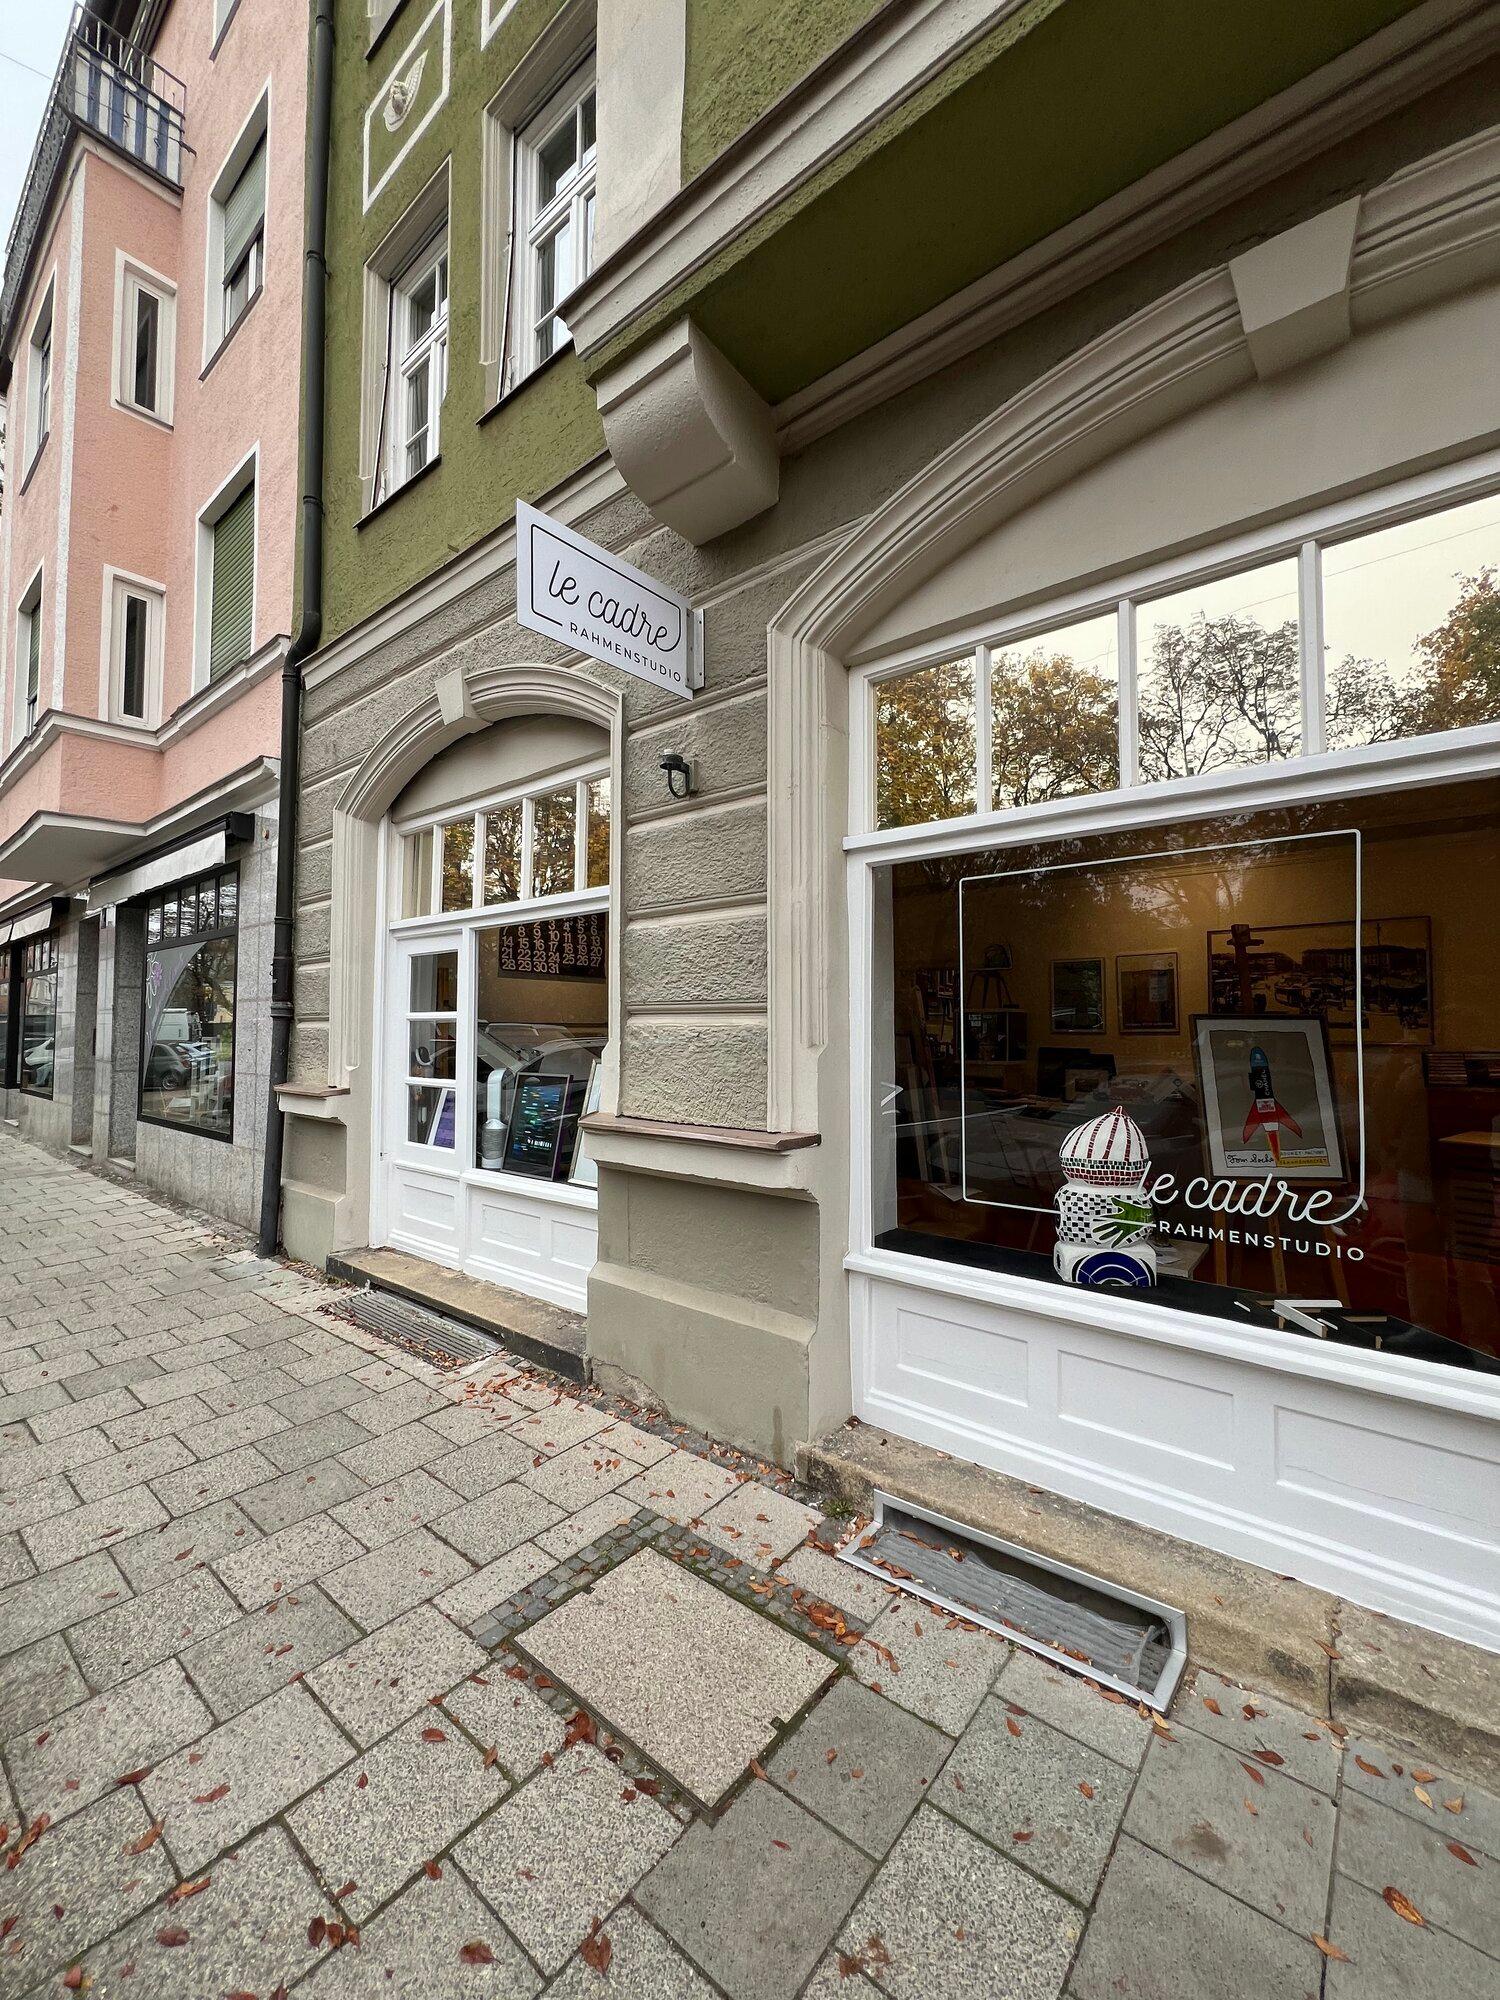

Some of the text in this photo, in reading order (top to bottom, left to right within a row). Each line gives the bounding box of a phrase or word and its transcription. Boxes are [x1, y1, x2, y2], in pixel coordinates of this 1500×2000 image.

[549, 560, 678, 652] le cadre
[570, 622, 681, 682] RAHMENSTUDIO
[518, 926, 525, 937] 8
[534, 929, 541, 939] 9
[549, 931, 560, 941] 10
[563, 932, 571, 942] 11
[577, 934, 586, 945] 12
[591, 936, 600, 946] 13
[548, 921, 555, 930] 3
[591, 926, 597, 935] 6
[502, 936, 602, 956] 14 15 16 17 18 19 20
[502, 947, 601, 967] 21 22 23 24 25 26 27
[502, 959, 559, 973] 28 29 30 31
[1138, 1160, 1350, 1225] le cadre
[1160, 1221, 1364, 1261] RAHMENSTUDIO
